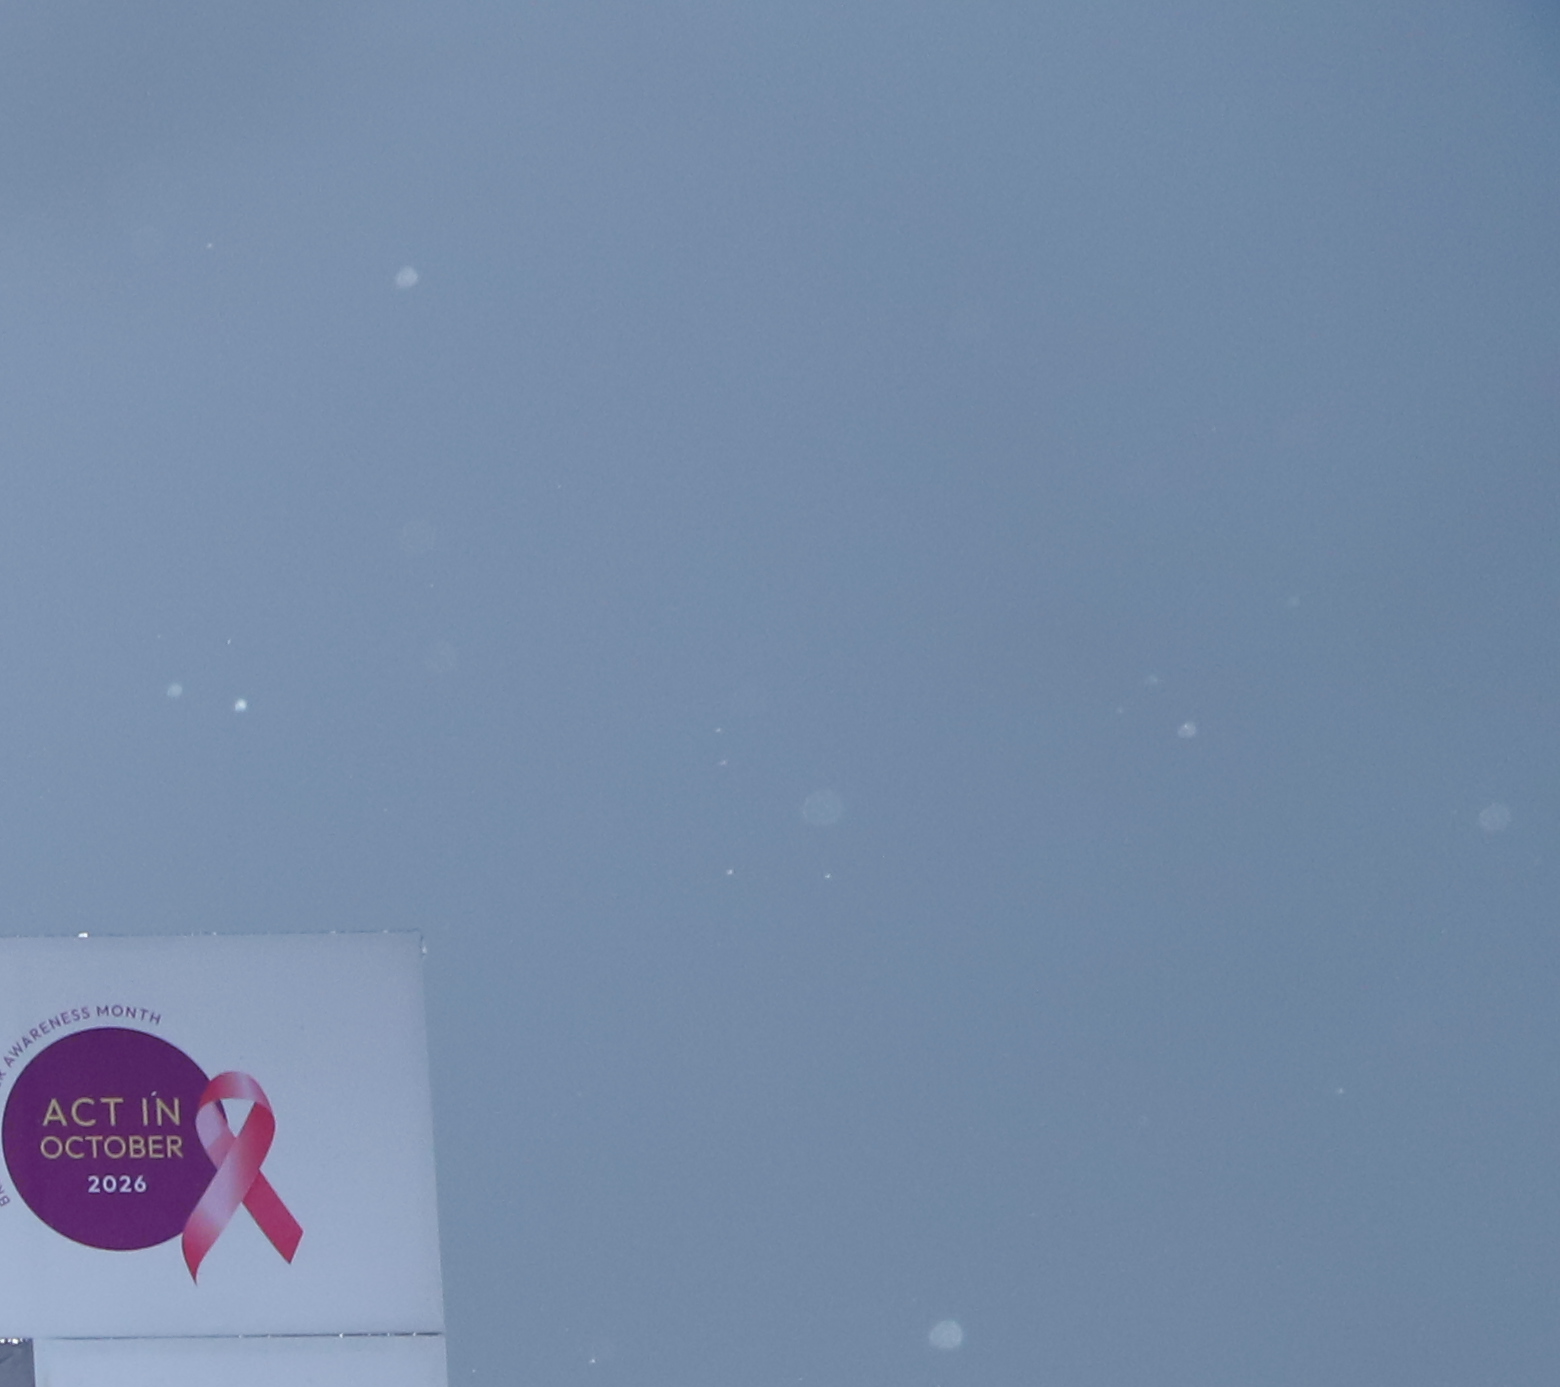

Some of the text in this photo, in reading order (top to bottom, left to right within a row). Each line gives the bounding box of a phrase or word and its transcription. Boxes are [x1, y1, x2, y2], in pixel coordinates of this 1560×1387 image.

[3, 1006, 91, 1068] AWARENESS
[96, 1005, 162, 1025] MONTH
[43, 1098, 181, 1127] ACT IN
[40, 1135, 184, 1160] OCTOBER
[88, 1176, 147, 1194] 2026
